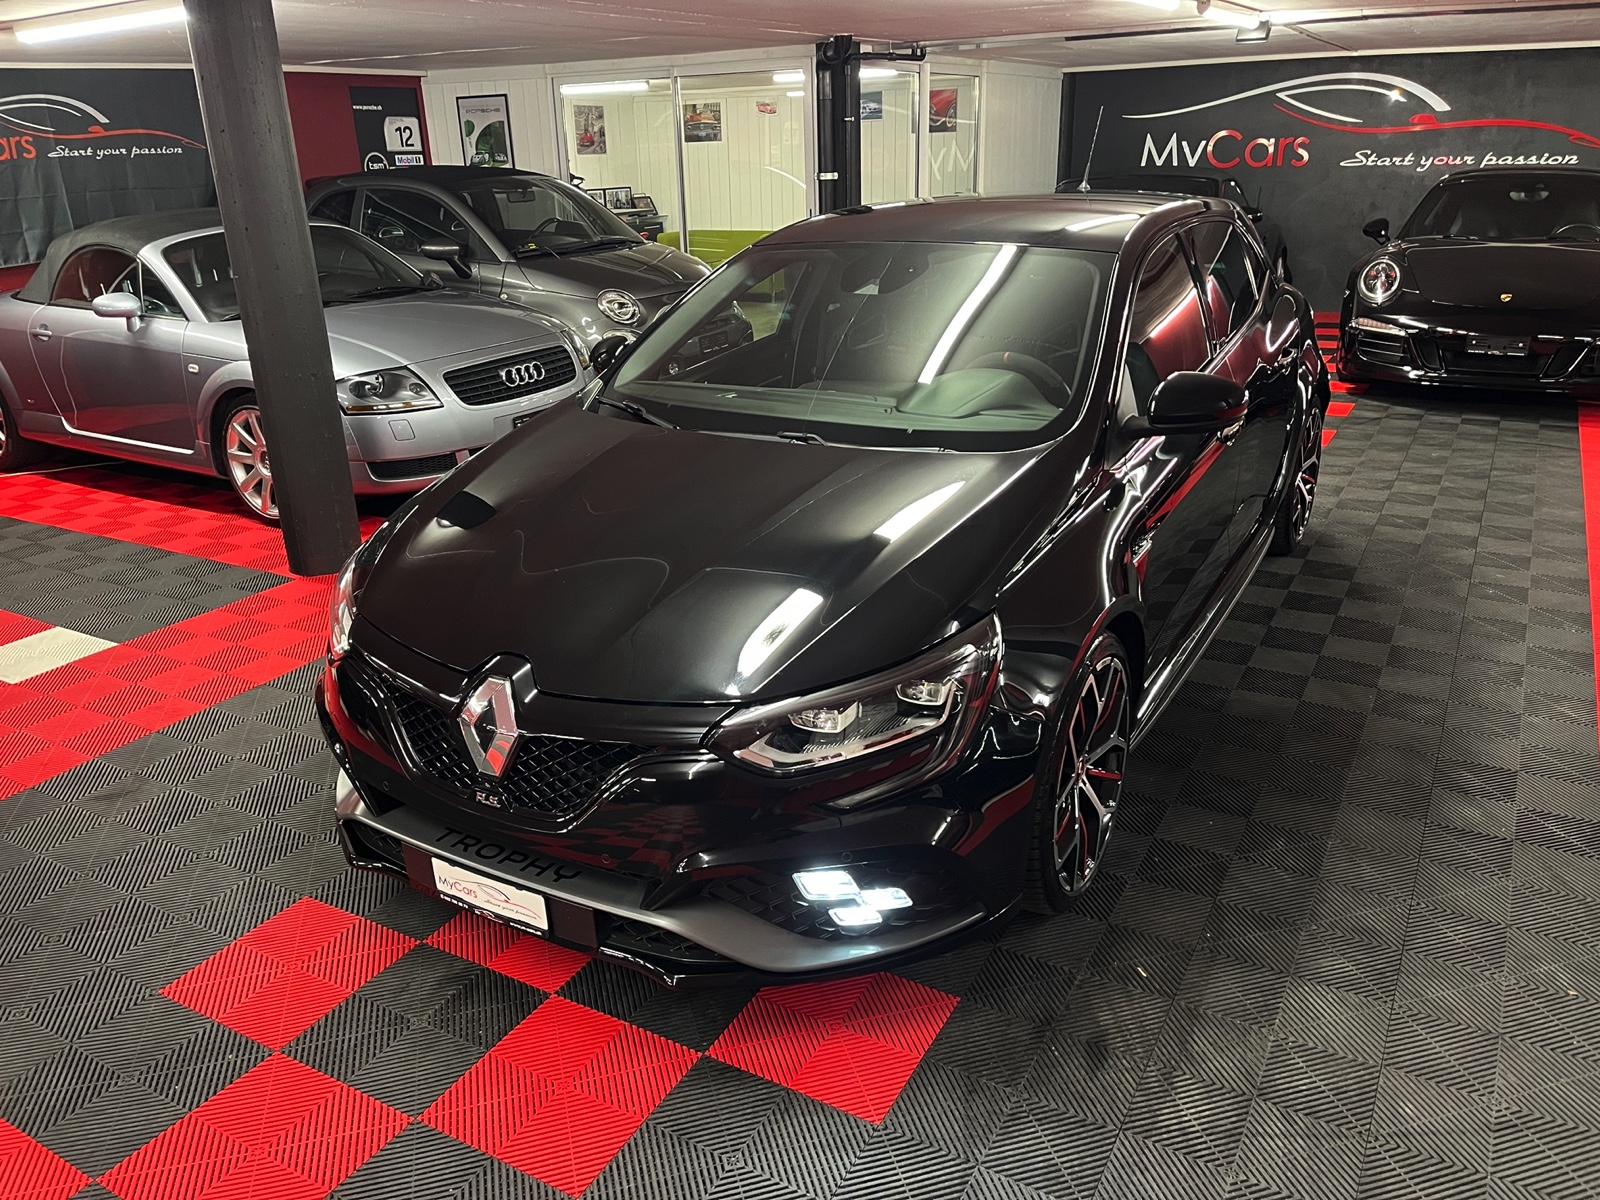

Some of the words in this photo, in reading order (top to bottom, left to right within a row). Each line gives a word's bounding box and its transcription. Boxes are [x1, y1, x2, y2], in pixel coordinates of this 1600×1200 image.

[394, 125, 415, 148] 12
[47, 145, 93, 158] Start
[96, 147, 128, 160] your
[131, 146, 183, 159] passion
[397, 156, 415, 165] Mobil
[1339, 150, 1415, 167] Start
[1416, 154, 1476, 172] your
[1479, 152, 1580, 168] passion
[435, 827, 583, 883] TROPHY
[438, 875, 478, 899] MyCars
